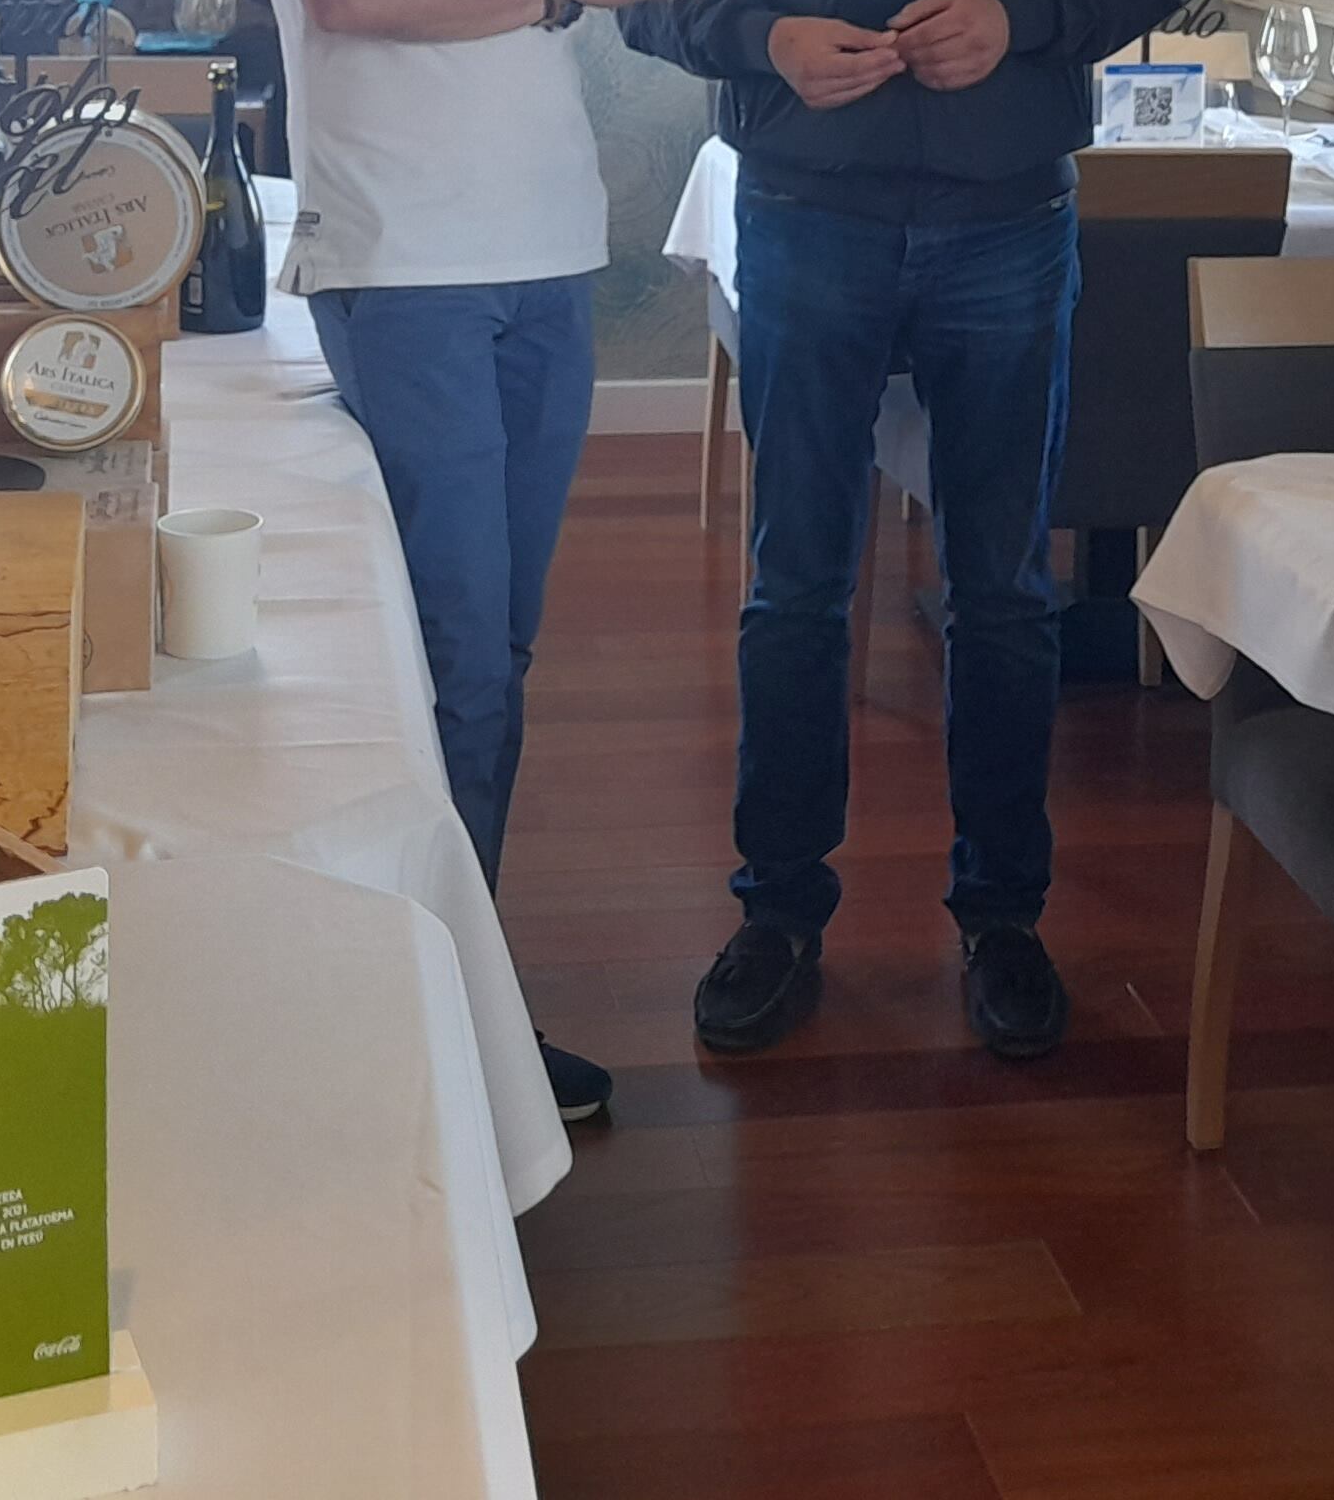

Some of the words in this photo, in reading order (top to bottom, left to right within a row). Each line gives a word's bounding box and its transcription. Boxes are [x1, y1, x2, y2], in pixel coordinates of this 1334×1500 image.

[62, 367, 115, 392] ITALICA
[10, 1208, 75, 1232] PLATAFORMA
[1, 1238, 15, 1250] EN
